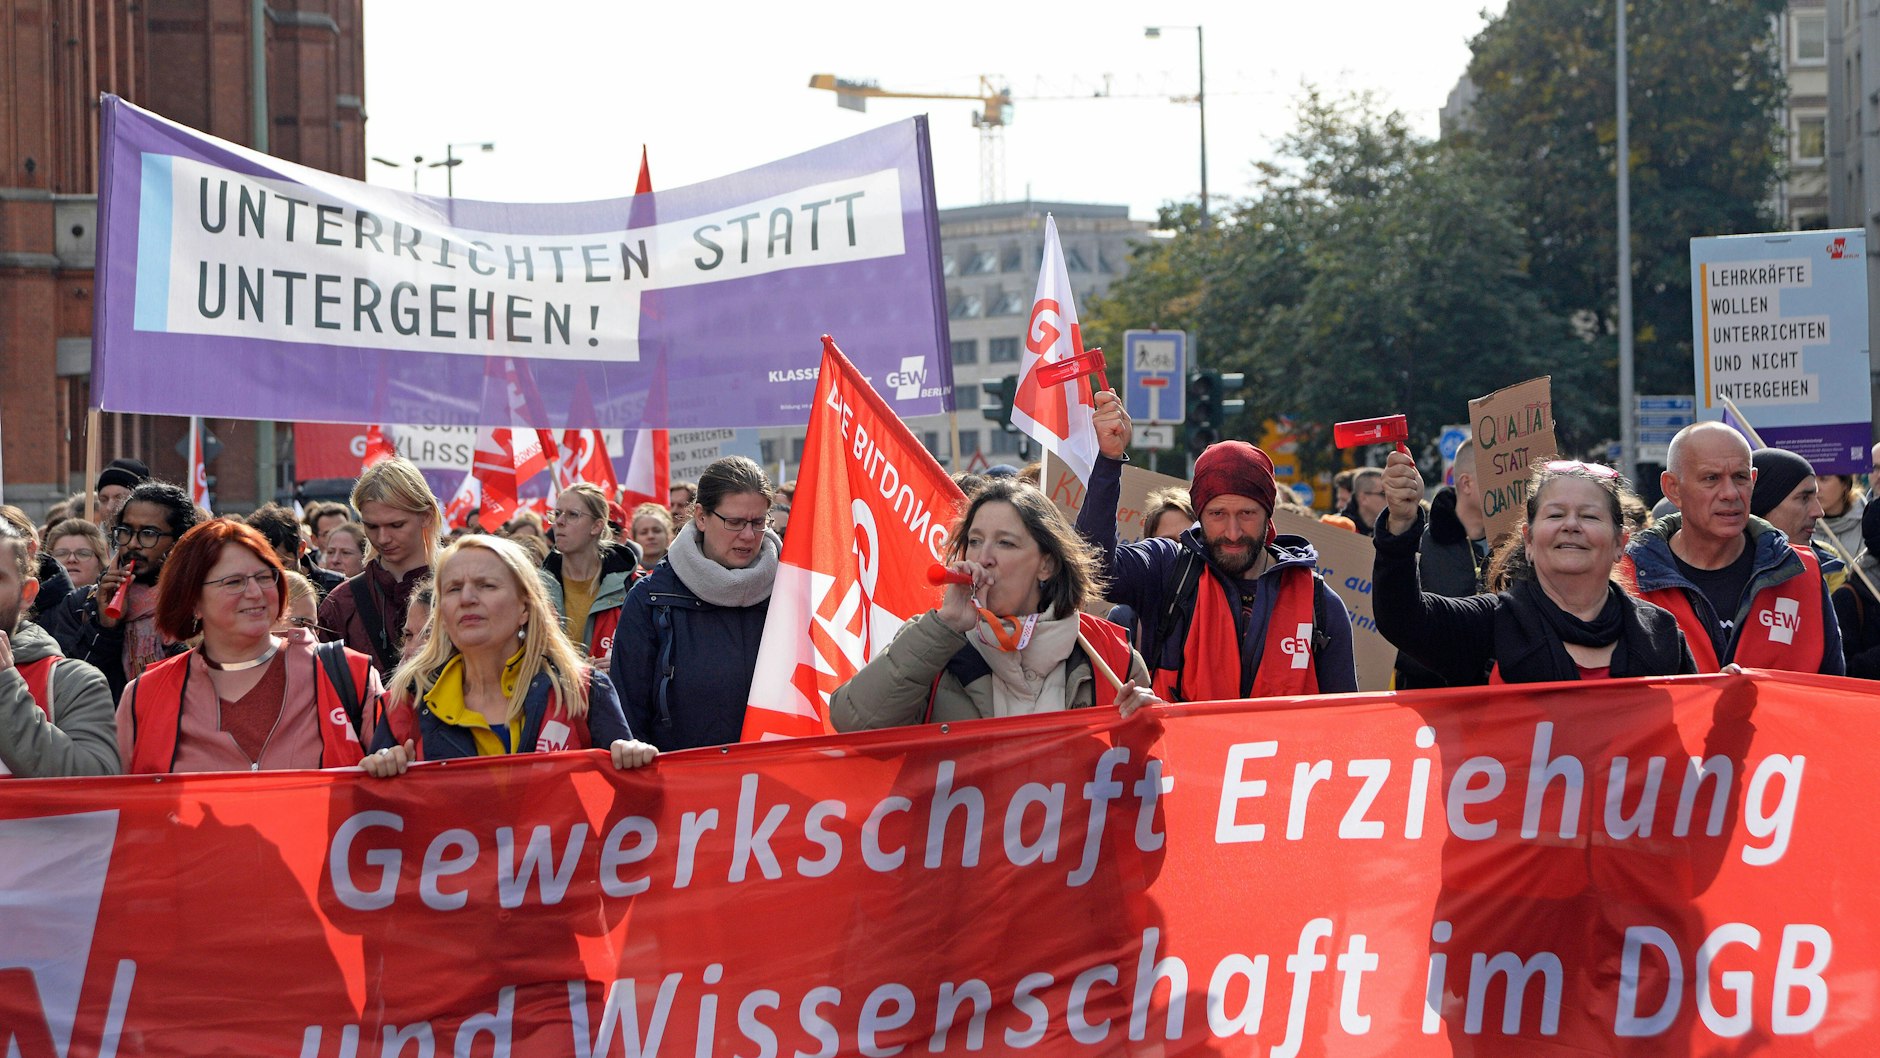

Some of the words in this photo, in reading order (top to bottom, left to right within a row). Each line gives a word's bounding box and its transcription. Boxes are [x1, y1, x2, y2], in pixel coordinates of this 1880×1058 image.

[200, 177, 650, 283] UNTERRICHTEN
[694, 191, 865, 271] STATT
[1711, 265, 1805, 287] LEHRKRÄFTE
[198, 261, 600, 347] UNTERGEHEN!
[1711, 296, 1768, 315] WOLLEN
[1713, 321, 1826, 343] UNTERRICHTEN
[1714, 354, 1742, 372] UND
[1752, 352, 1798, 370] NICHT
[886, 369, 928, 388] GEW
[1715, 379, 1809, 400] UNTERGEHEN
[921, 385, 951, 398] BERLIN
[1479, 400, 1550, 450] QUALITÄT
[1493, 446, 1529, 475] STATT
[1758, 608, 1801, 632] GEW
[330, 746, 1175, 911] Gewerkschaft
[1214, 720, 1807, 867] Erziehung
[568, 918, 1379, 1058] Wissenschaft
[1421, 920, 1564, 1036] im
[1613, 922, 1833, 1038] DGB
